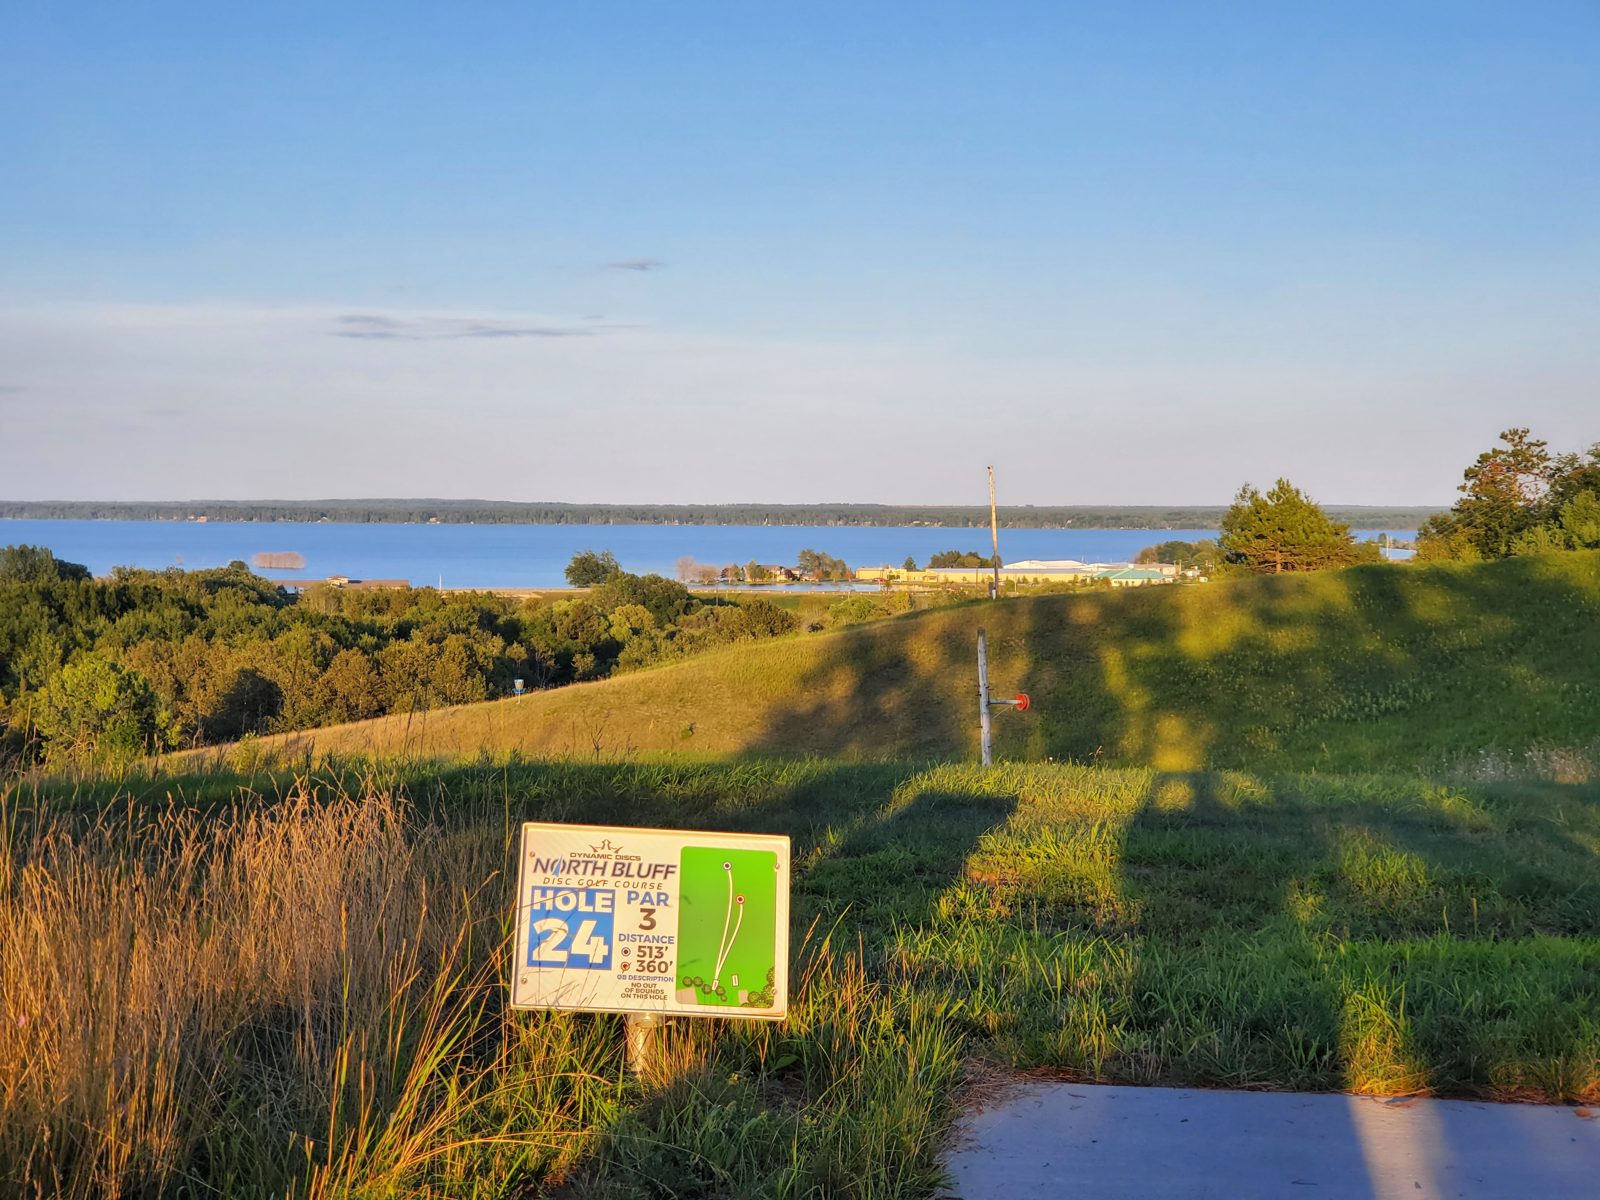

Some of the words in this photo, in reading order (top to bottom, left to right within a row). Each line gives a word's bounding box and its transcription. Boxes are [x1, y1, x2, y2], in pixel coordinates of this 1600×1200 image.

[570, 852, 612, 860] DYNAMIC
[533, 857, 608, 876] NORTH
[611, 862, 677, 880] BLUFF
[543, 877, 573, 886] DISC
[578, 878, 608, 887] GOLF
[614, 880, 663, 890] COURSE
[533, 889, 613, 913] HOLE
[627, 890, 669, 906] PAR
[638, 907, 657, 931] 3
[532, 917, 608, 964] 24
[618, 933, 675, 944] DISTANCE
